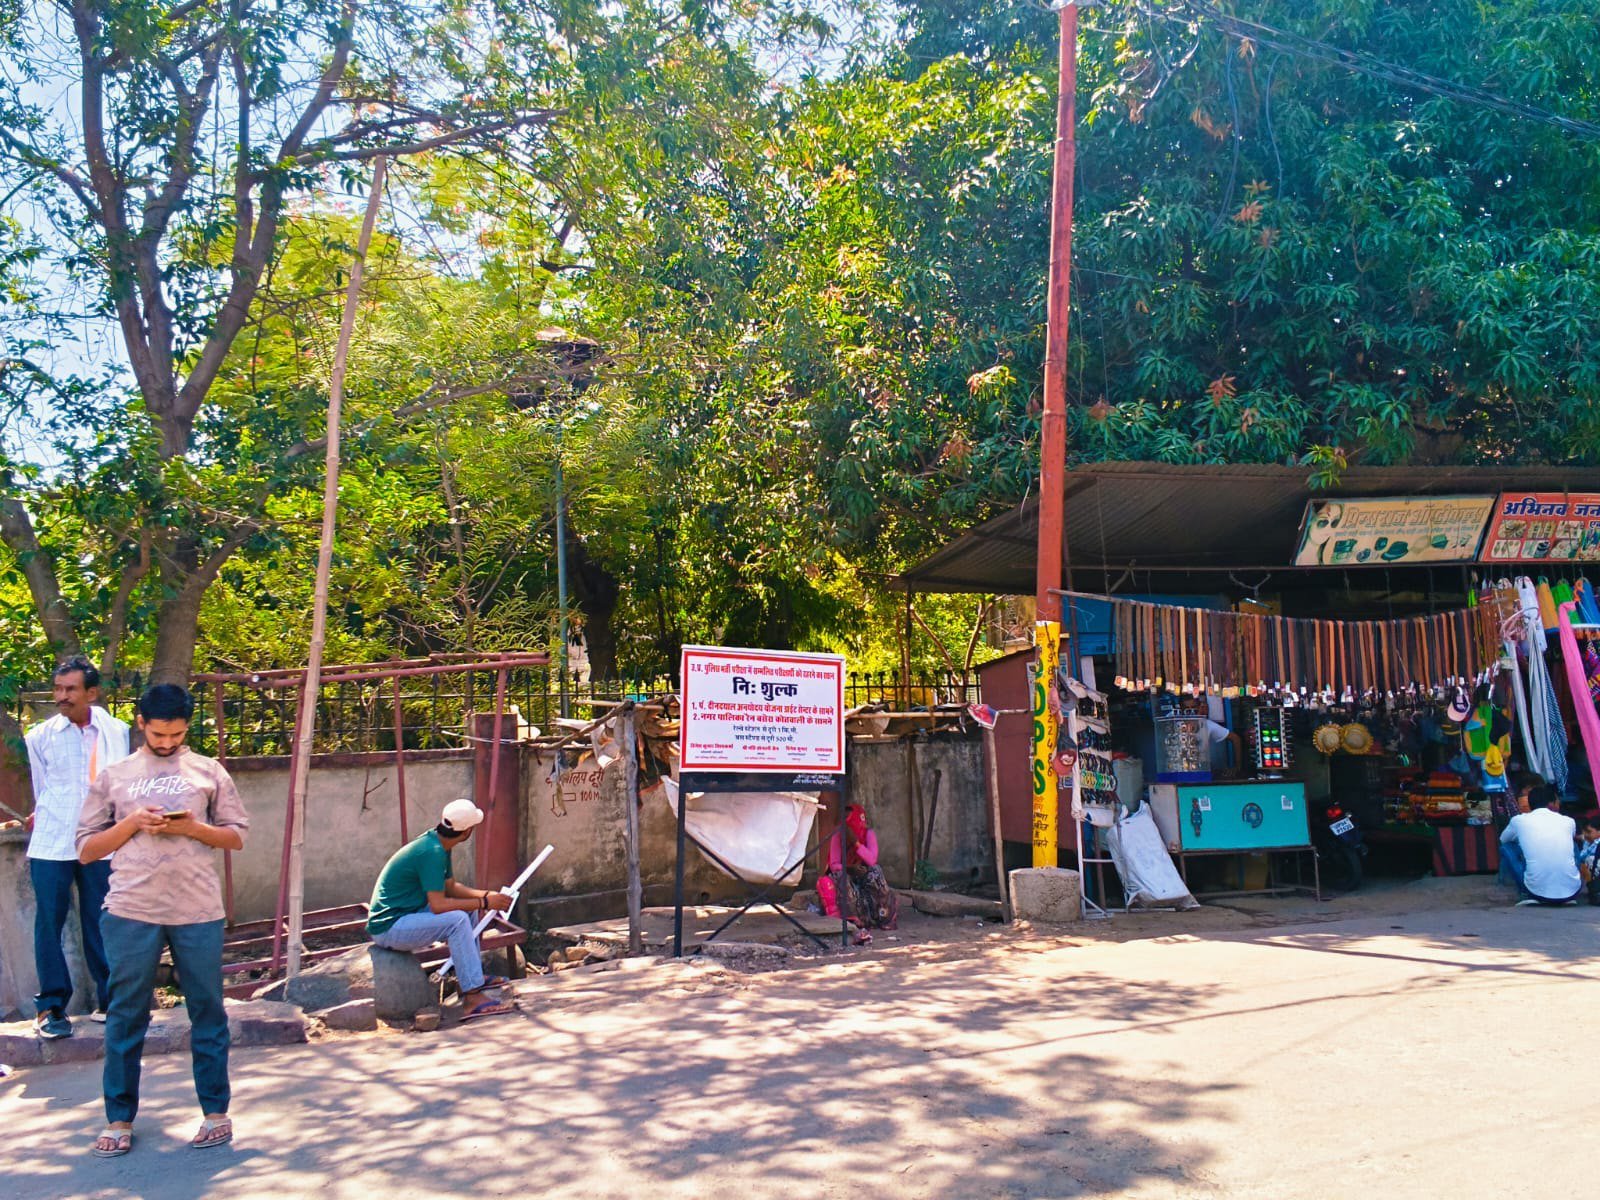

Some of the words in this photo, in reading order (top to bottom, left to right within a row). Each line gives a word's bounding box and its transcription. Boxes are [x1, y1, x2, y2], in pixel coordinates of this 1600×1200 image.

[1503, 497, 1568, 516] अभिनव
[704, 662, 720, 675] पुलिस
[795, 667, 802, 678] को
[761, 682, 798, 702] शुल्क
[708, 700, 736, 711] दीनदयाल
[764, 703, 783, 713] योजना
[812, 704, 818, 714] के
[819, 705, 834, 716] सामने
[718, 711, 745, 721] पालिका
[757, 713, 774, 723] बसेरा
[775, 714, 805, 724] कोतवाली
[807, 716, 814, 724] के
[815, 716, 832, 725] सामने
[127, 775, 195, 799] HUSTLE
